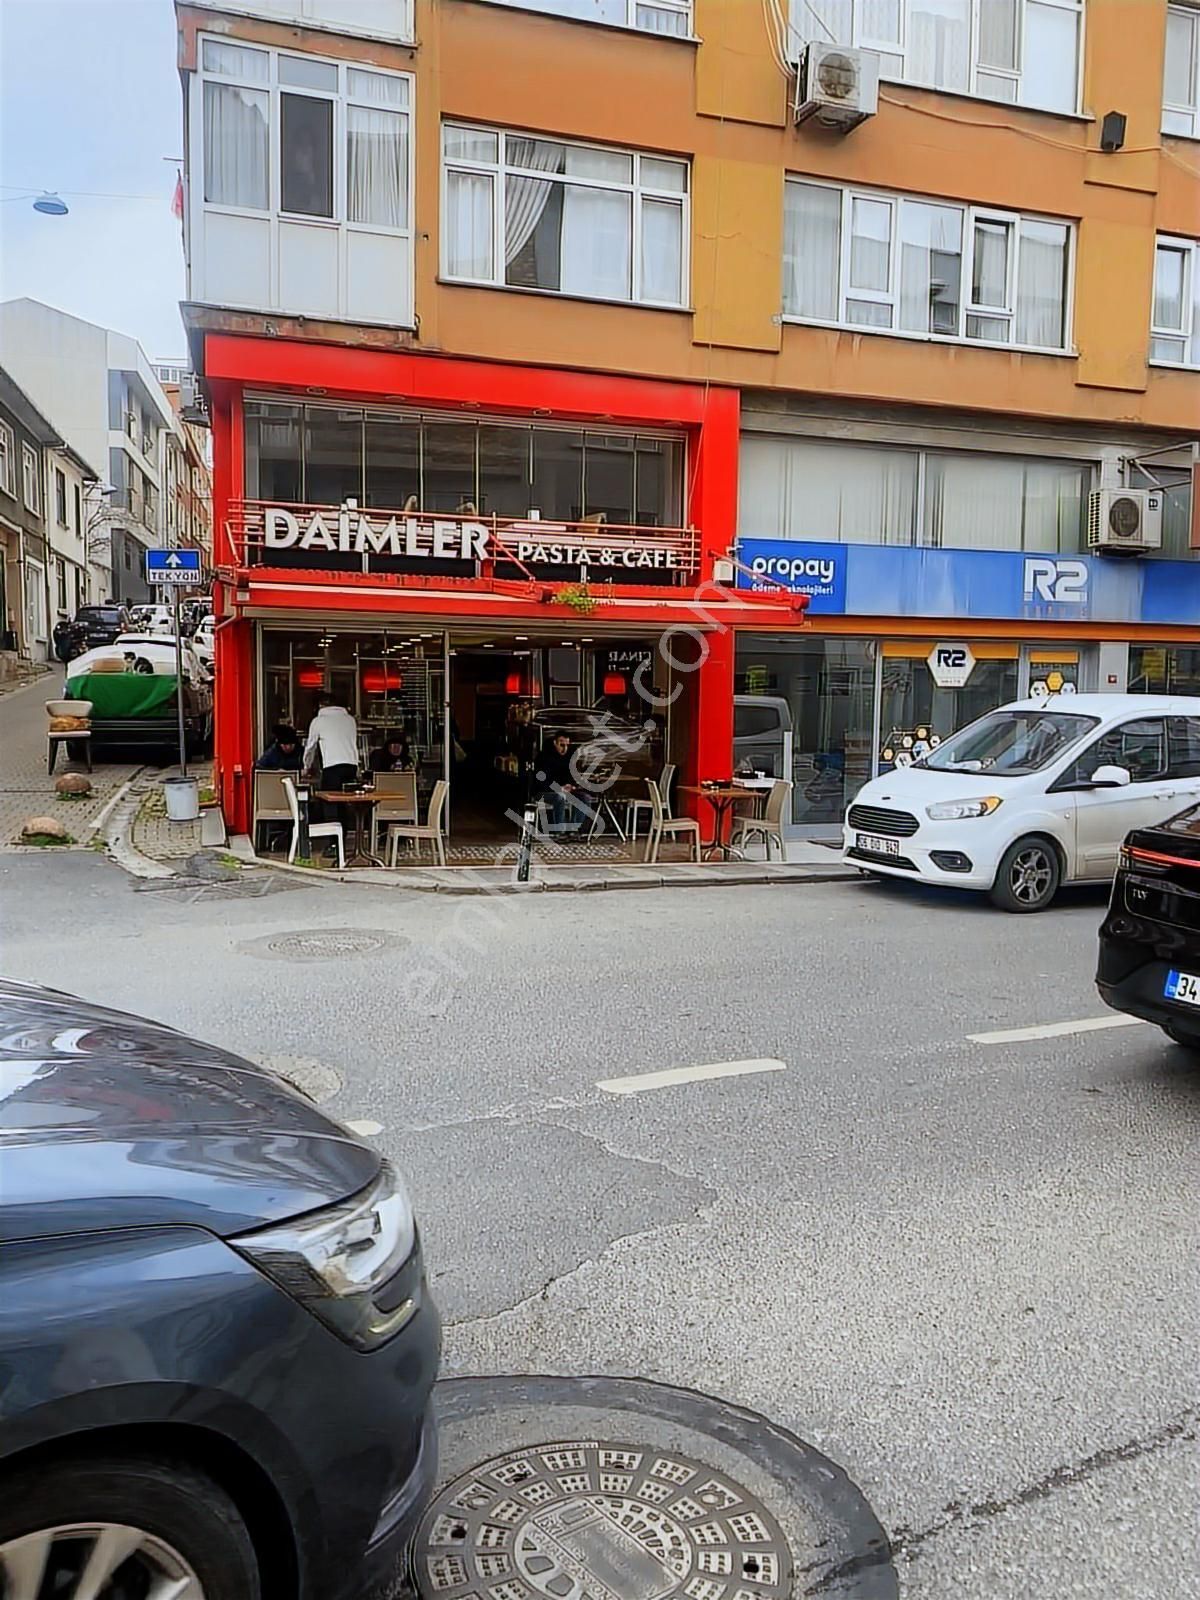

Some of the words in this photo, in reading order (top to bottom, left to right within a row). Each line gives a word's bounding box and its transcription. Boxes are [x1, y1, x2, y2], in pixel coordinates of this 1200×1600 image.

[518, 541, 593, 565] PASTA
[600, 547, 616, 566] &
[622, 548, 678, 568] CAFE
[151, 571, 172, 581] TEK
[752, 557, 834, 583] propay
[1024, 558, 1088, 602] R2
[937, 649, 967, 668] R2
[1178, 976, 1197, 1001] 34
